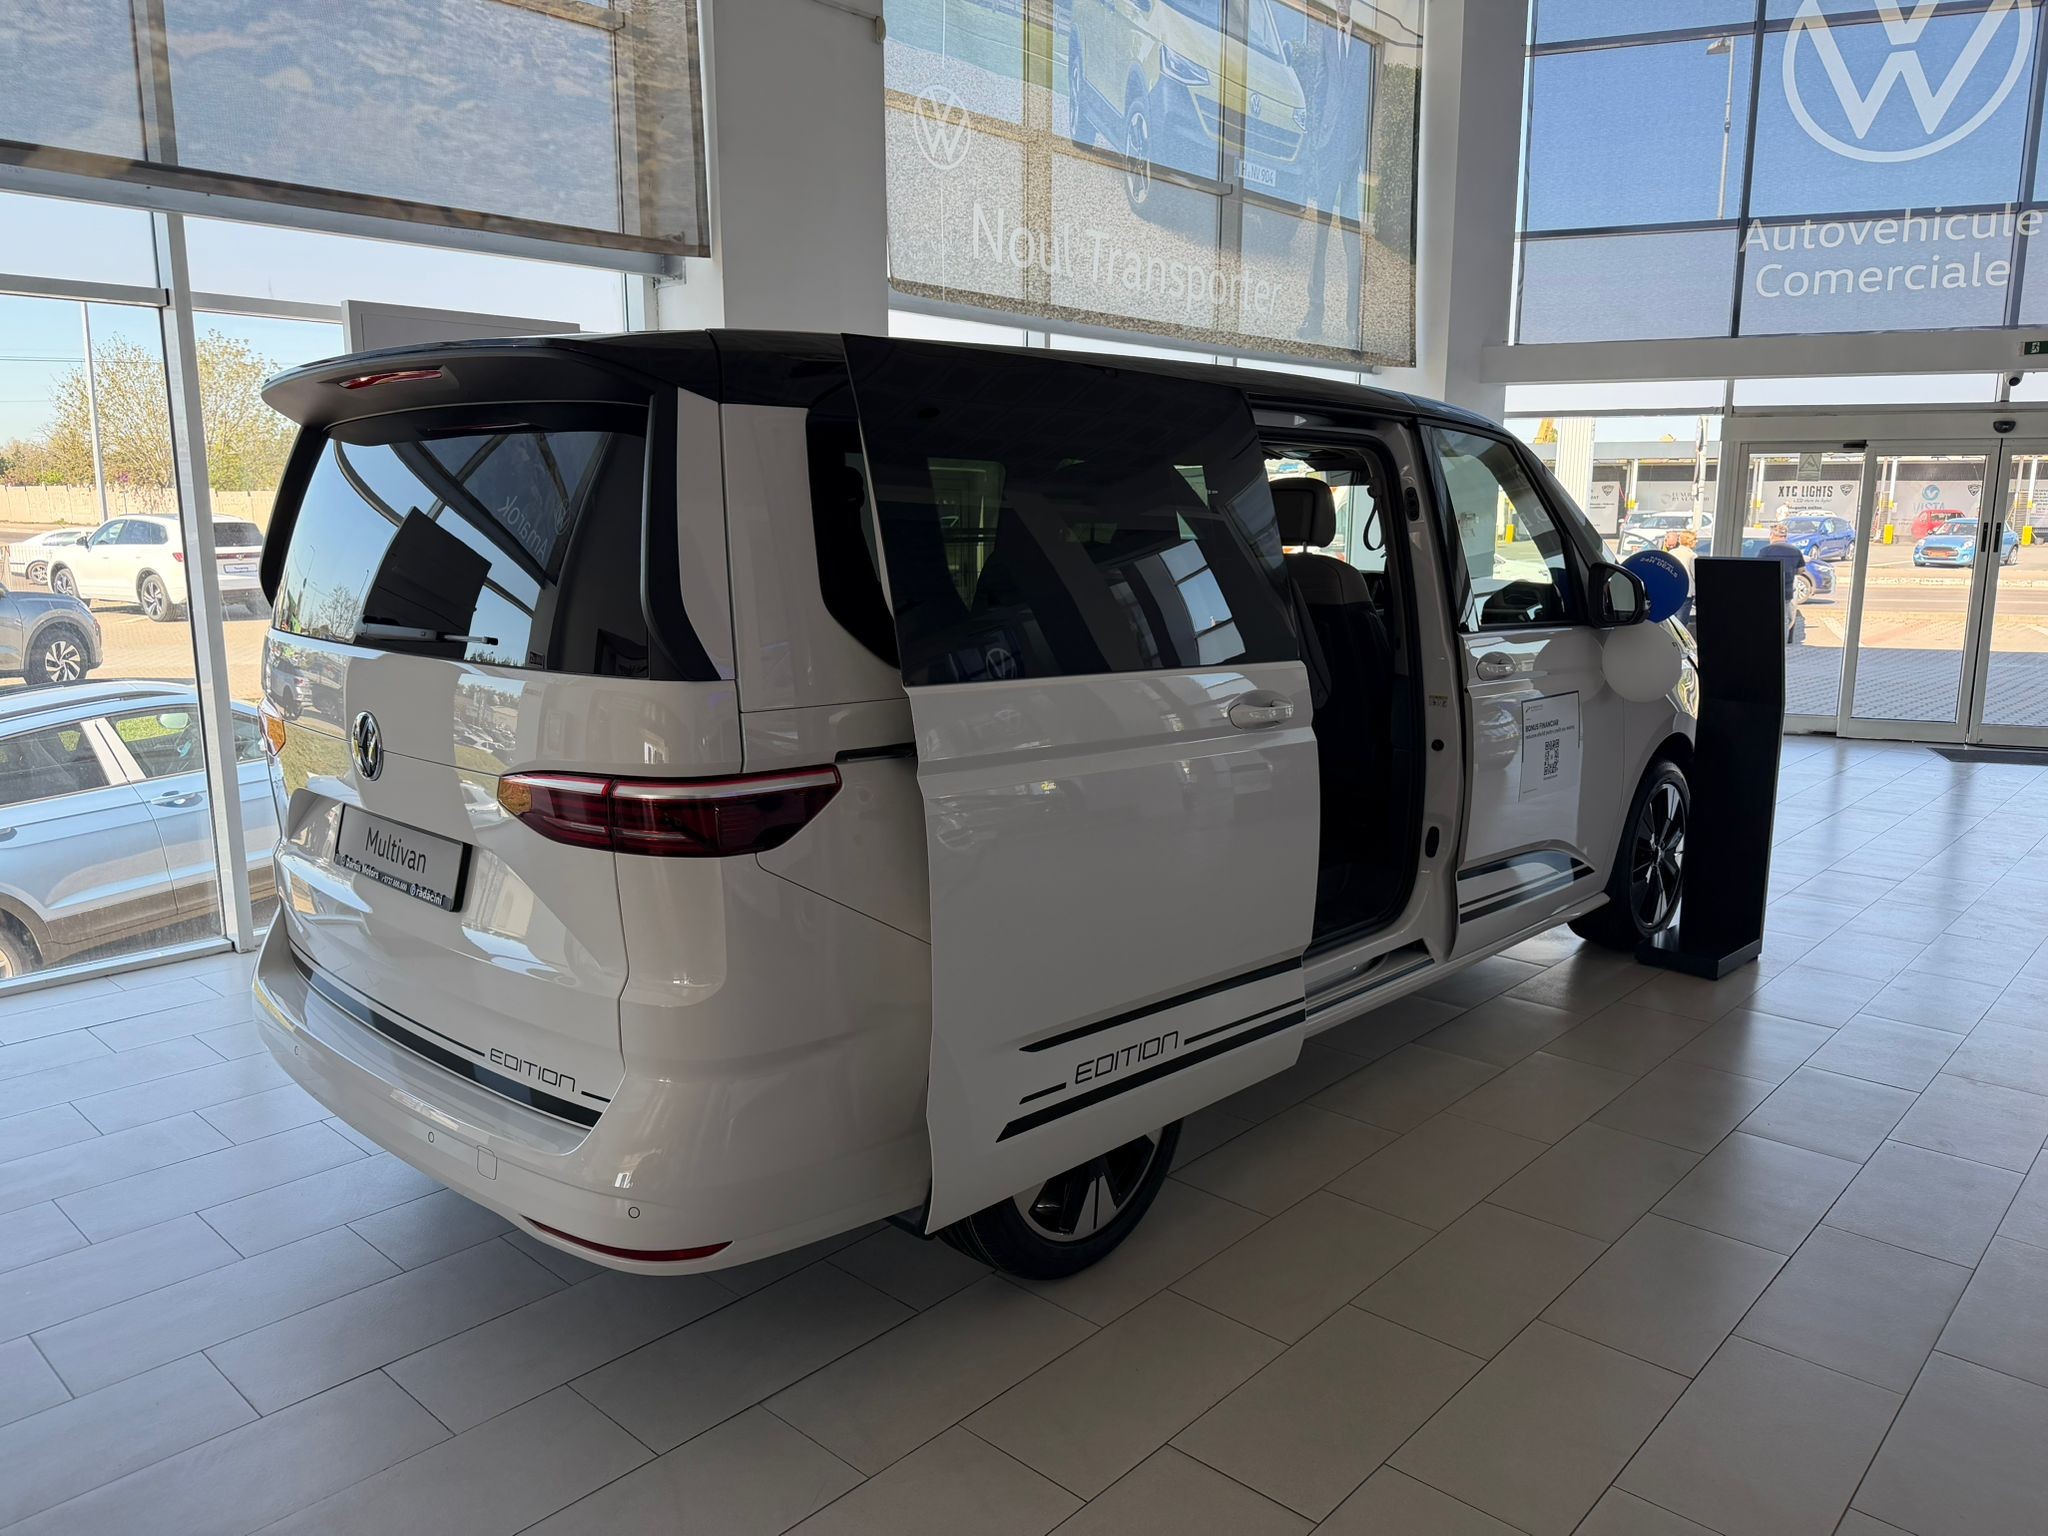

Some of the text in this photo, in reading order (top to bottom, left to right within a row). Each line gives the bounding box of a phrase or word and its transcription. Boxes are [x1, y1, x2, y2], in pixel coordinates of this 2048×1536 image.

[1739, 201, 2044, 253] Autovehicule
[972, 202, 1283, 316] Noul Transporter
[1756, 251, 2011, 298] Comerciale
[1778, 485, 1834, 498] XTC LIGHTS
[365, 827, 427, 874] Multivan
[489, 1048, 576, 1093] EDITION
[1075, 1031, 1179, 1084] EDITION
